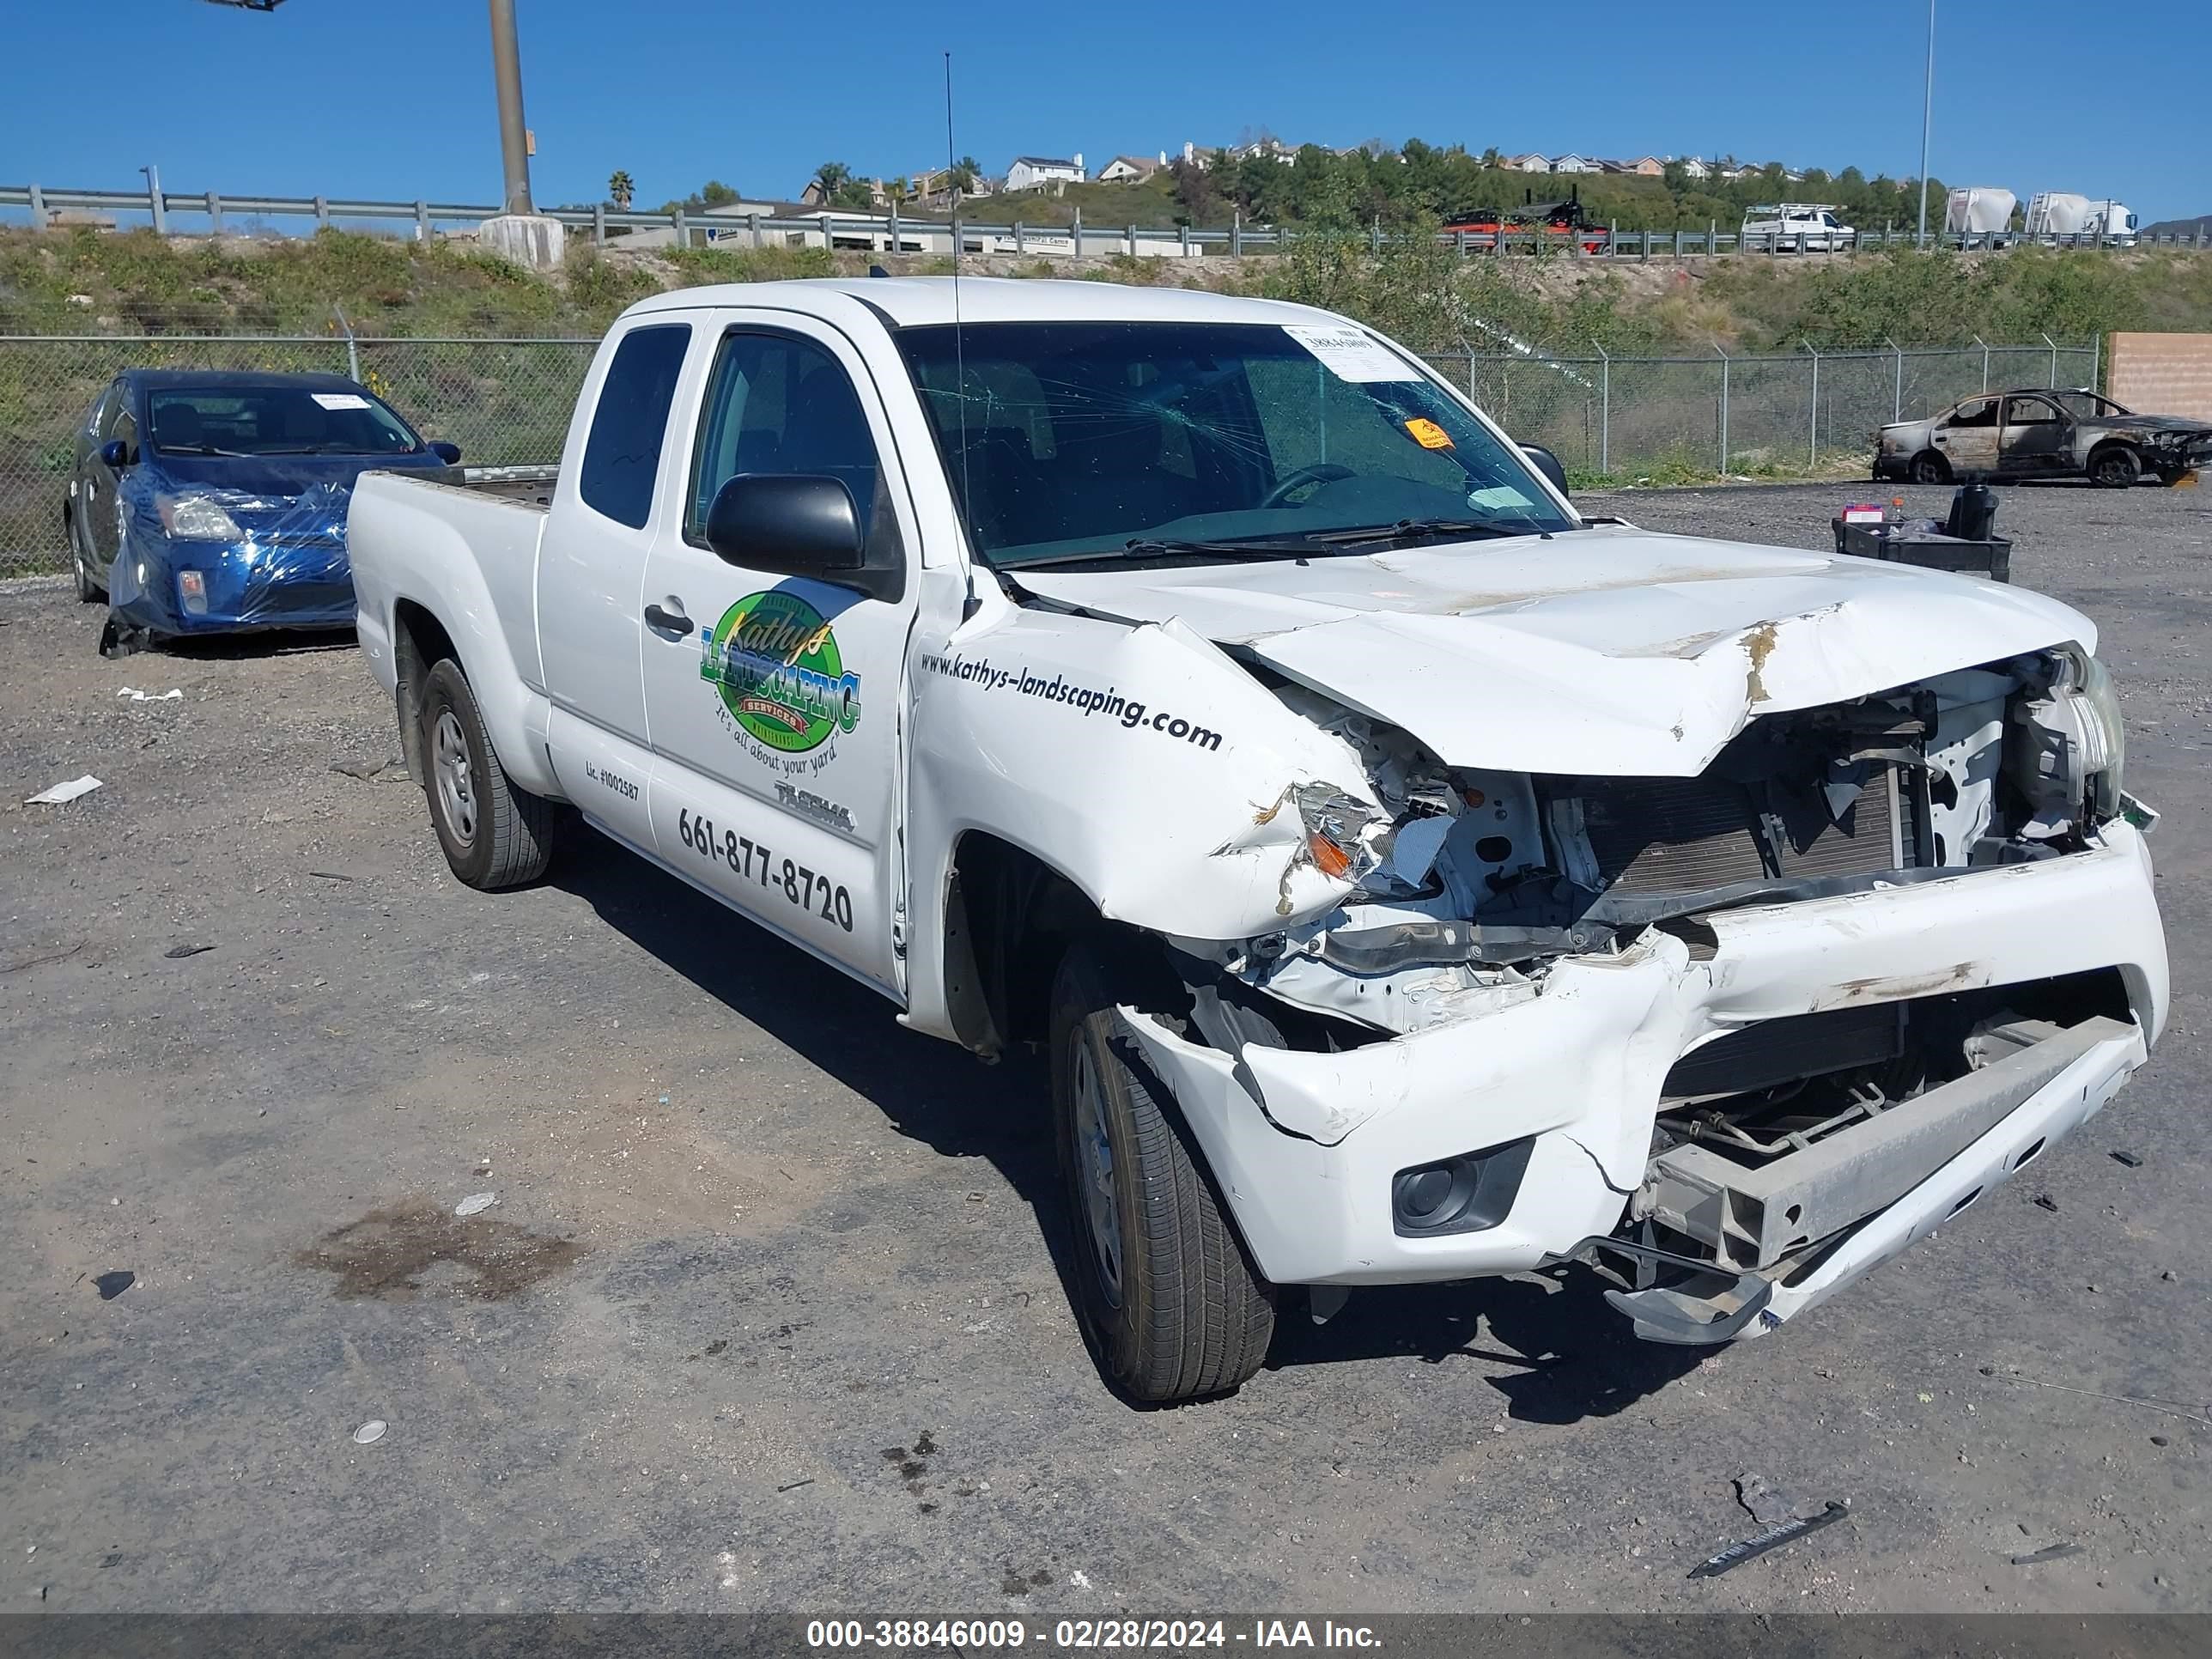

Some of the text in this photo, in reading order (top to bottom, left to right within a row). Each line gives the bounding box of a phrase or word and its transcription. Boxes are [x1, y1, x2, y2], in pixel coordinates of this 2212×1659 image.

[723, 611, 833, 667] Kathy's
[701, 626, 861, 733] LANDSCAPING
[921, 653, 1223, 752] www.kathys-landscaping.com
[748, 702, 796, 726] SERVICES
[586, 760, 639, 801] Lic. #1002587
[734, 731, 750, 750] all
[750, 744, 780, 770] about
[782, 758, 808, 779] your
[679, 807, 854, 933] 661-877-8720
